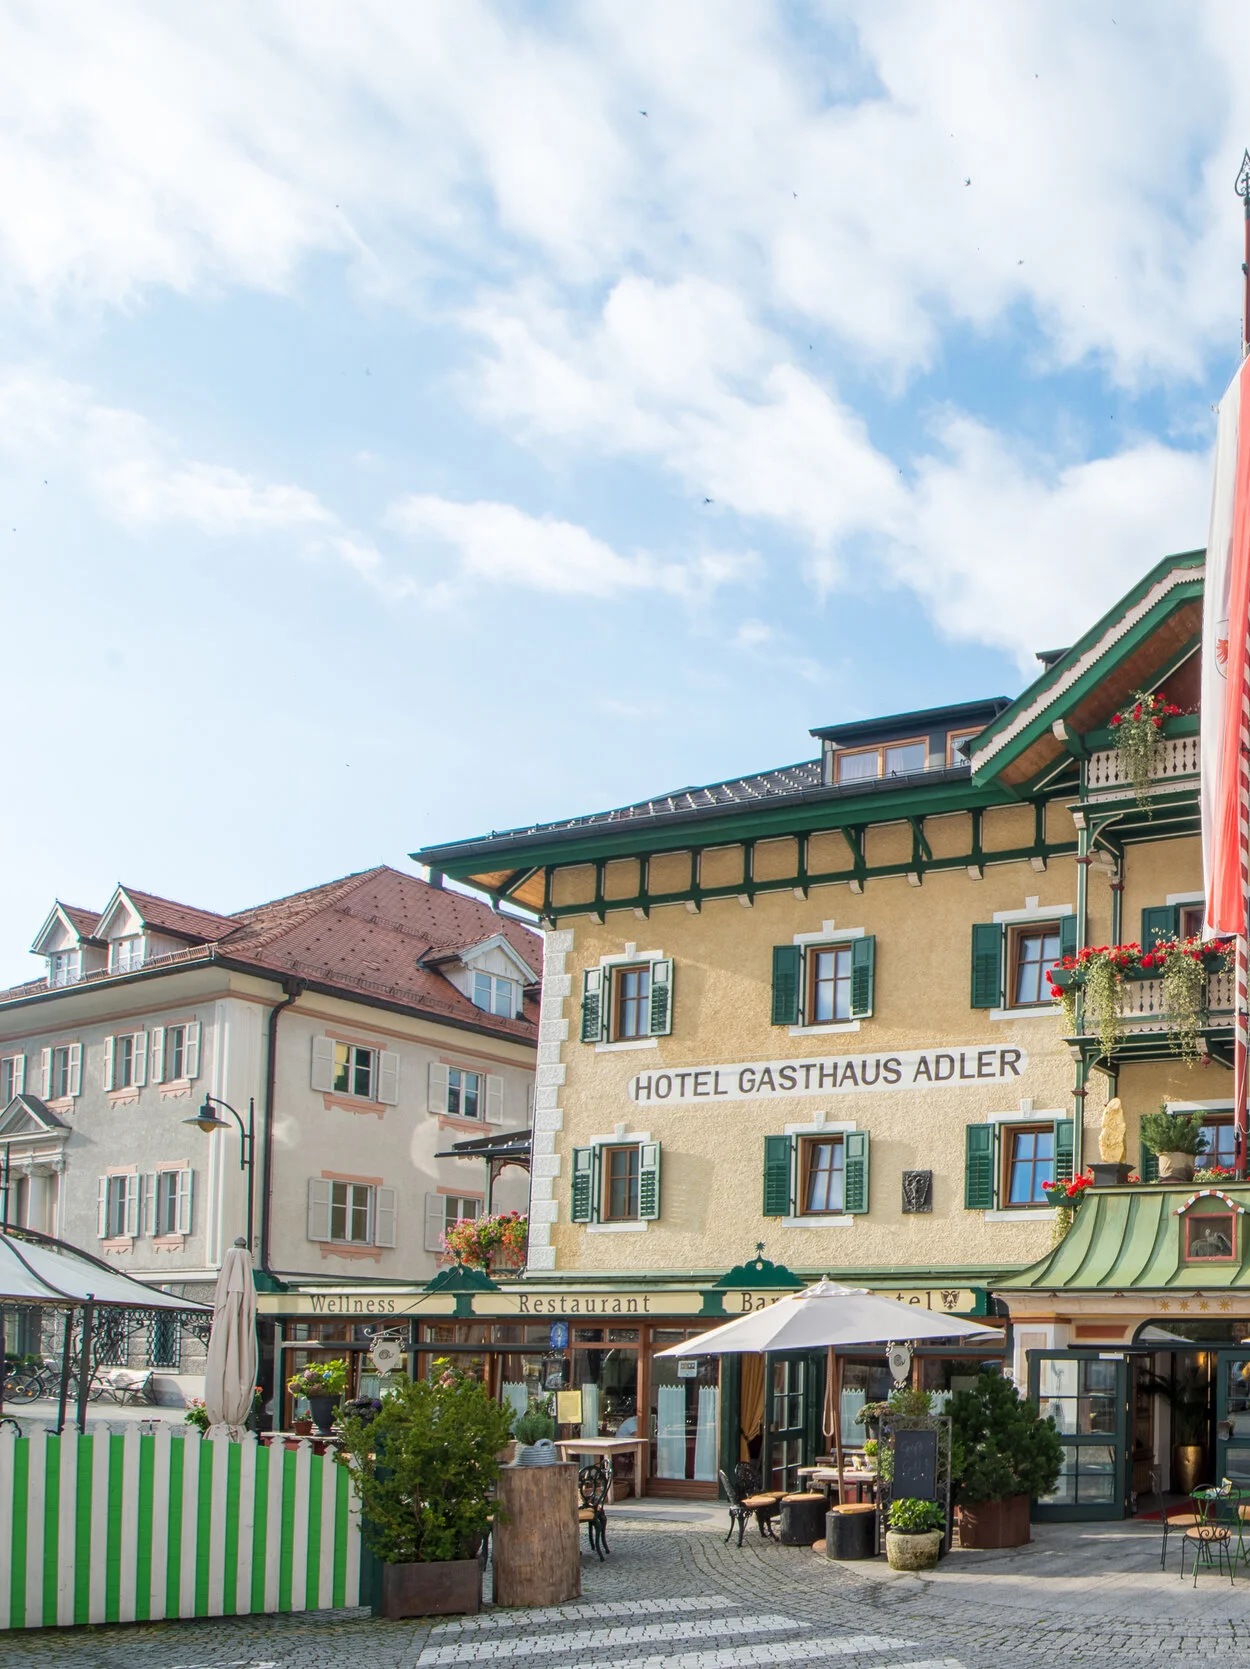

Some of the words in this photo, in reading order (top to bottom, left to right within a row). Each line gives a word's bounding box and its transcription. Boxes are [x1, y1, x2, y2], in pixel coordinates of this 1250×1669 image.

[634, 1071, 728, 1100] HOTEL
[738, 1057, 901, 1094] GASTHAUS
[912, 1048, 1022, 1083] ADLER
[310, 1294, 396, 1313] Wellness
[518, 1294, 651, 1313] Restaurant
[884, 1291, 933, 1311] tel
